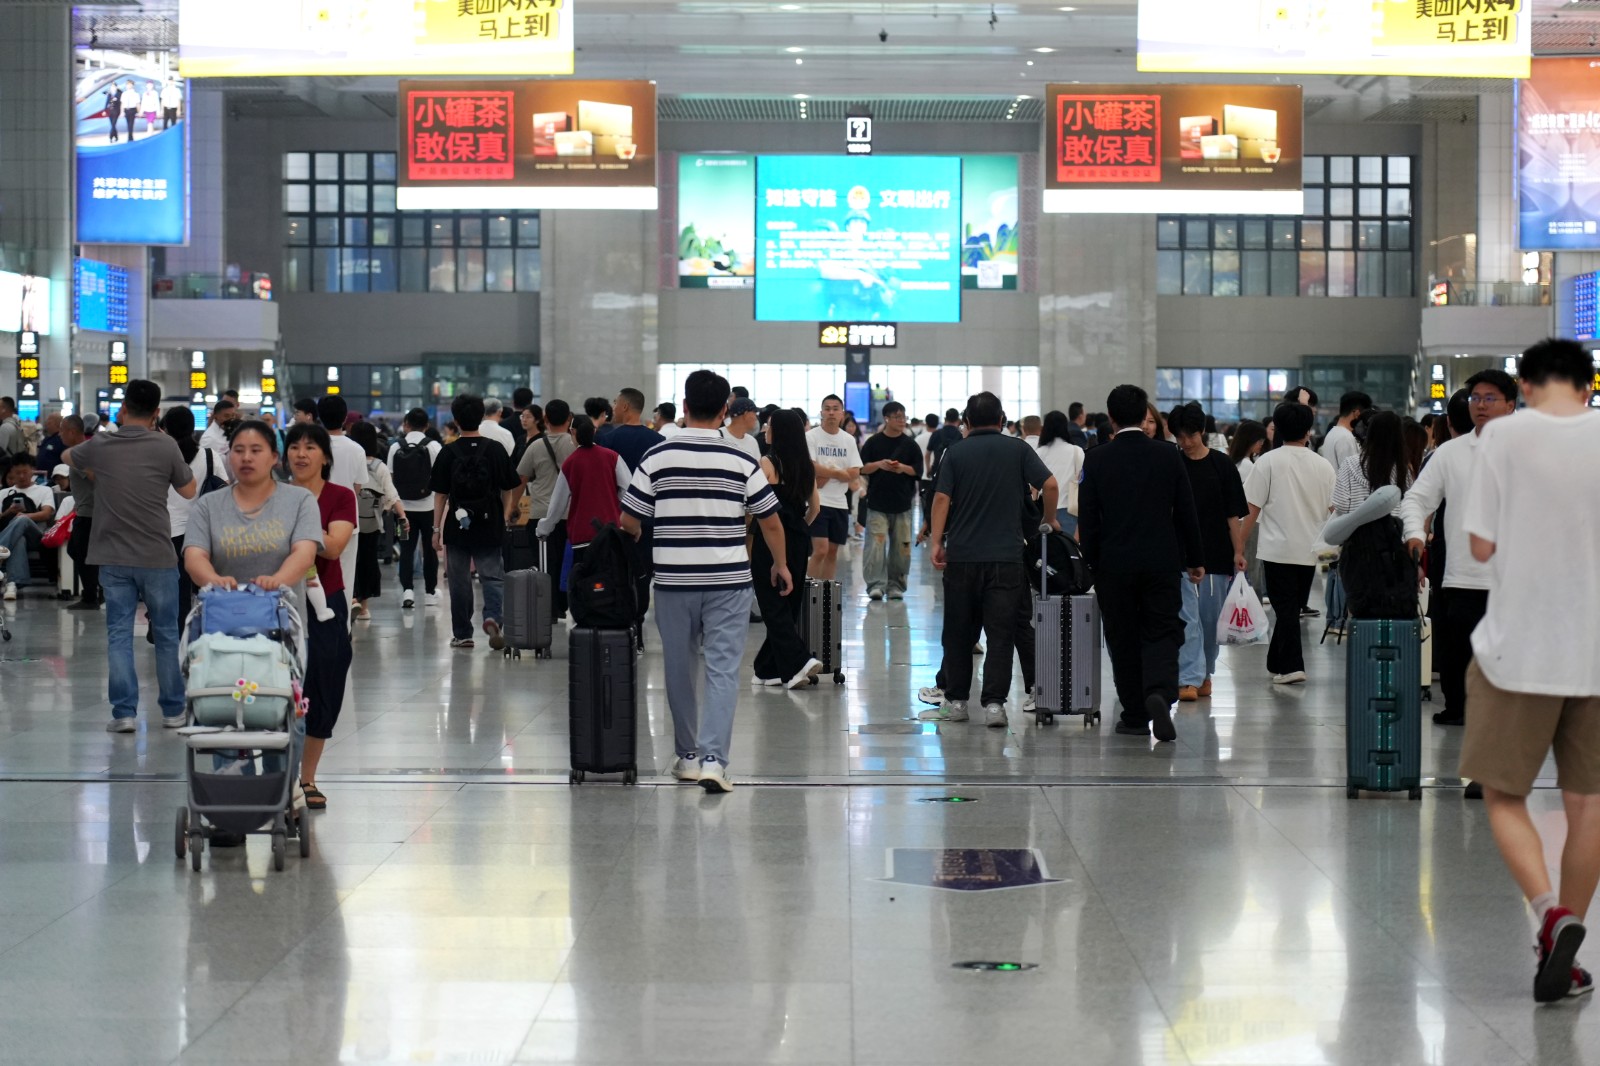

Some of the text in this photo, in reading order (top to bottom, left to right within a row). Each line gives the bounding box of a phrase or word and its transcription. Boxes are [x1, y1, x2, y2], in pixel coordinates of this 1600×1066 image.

[479, 12, 550, 39] 马上到
[1437, 16, 1508, 42] 马上到
[415, 97, 506, 128] 小罐茶
[1064, 101, 1153, 131] 小罐茶
[415, 131, 506, 161] 敢保真
[1064, 134, 1153, 164] 敢保真
[817, 446, 848, 458] INDIANA
